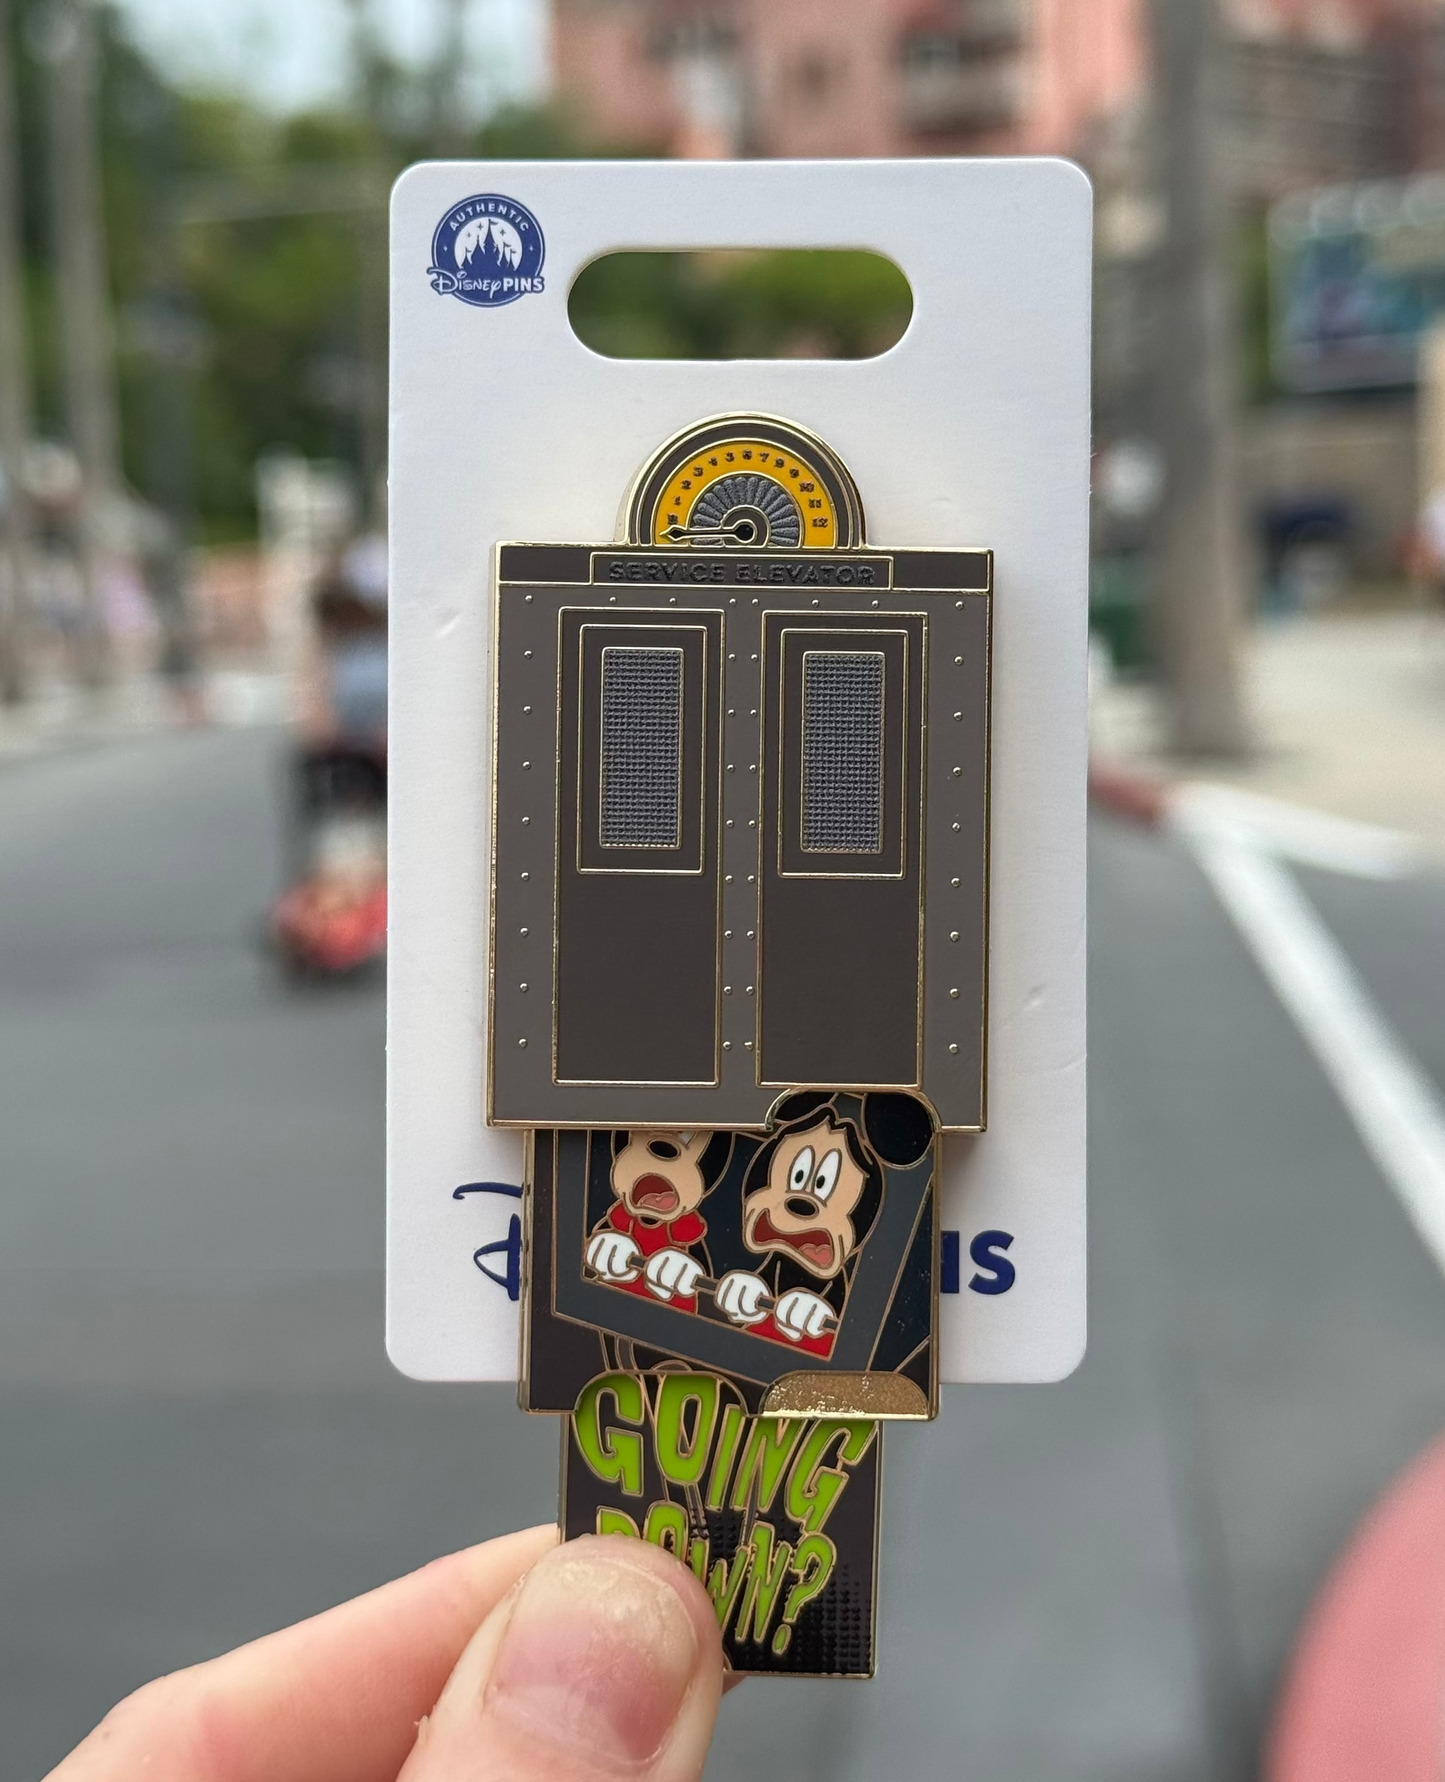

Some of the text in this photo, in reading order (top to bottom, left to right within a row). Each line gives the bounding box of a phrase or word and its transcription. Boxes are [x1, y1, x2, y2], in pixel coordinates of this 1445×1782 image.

[449, 202, 529, 232] AUTHENTIC
[502, 277, 544, 293] PINS
[681, 480, 692, 490] 2
[693, 467, 704, 477] 3
[759, 452, 770, 463] 7
[608, 560, 875, 585] SERVICE ELEVATOR
[571, 1372, 879, 1535] GOING
[596, 1499, 837, 1656] OWN?
